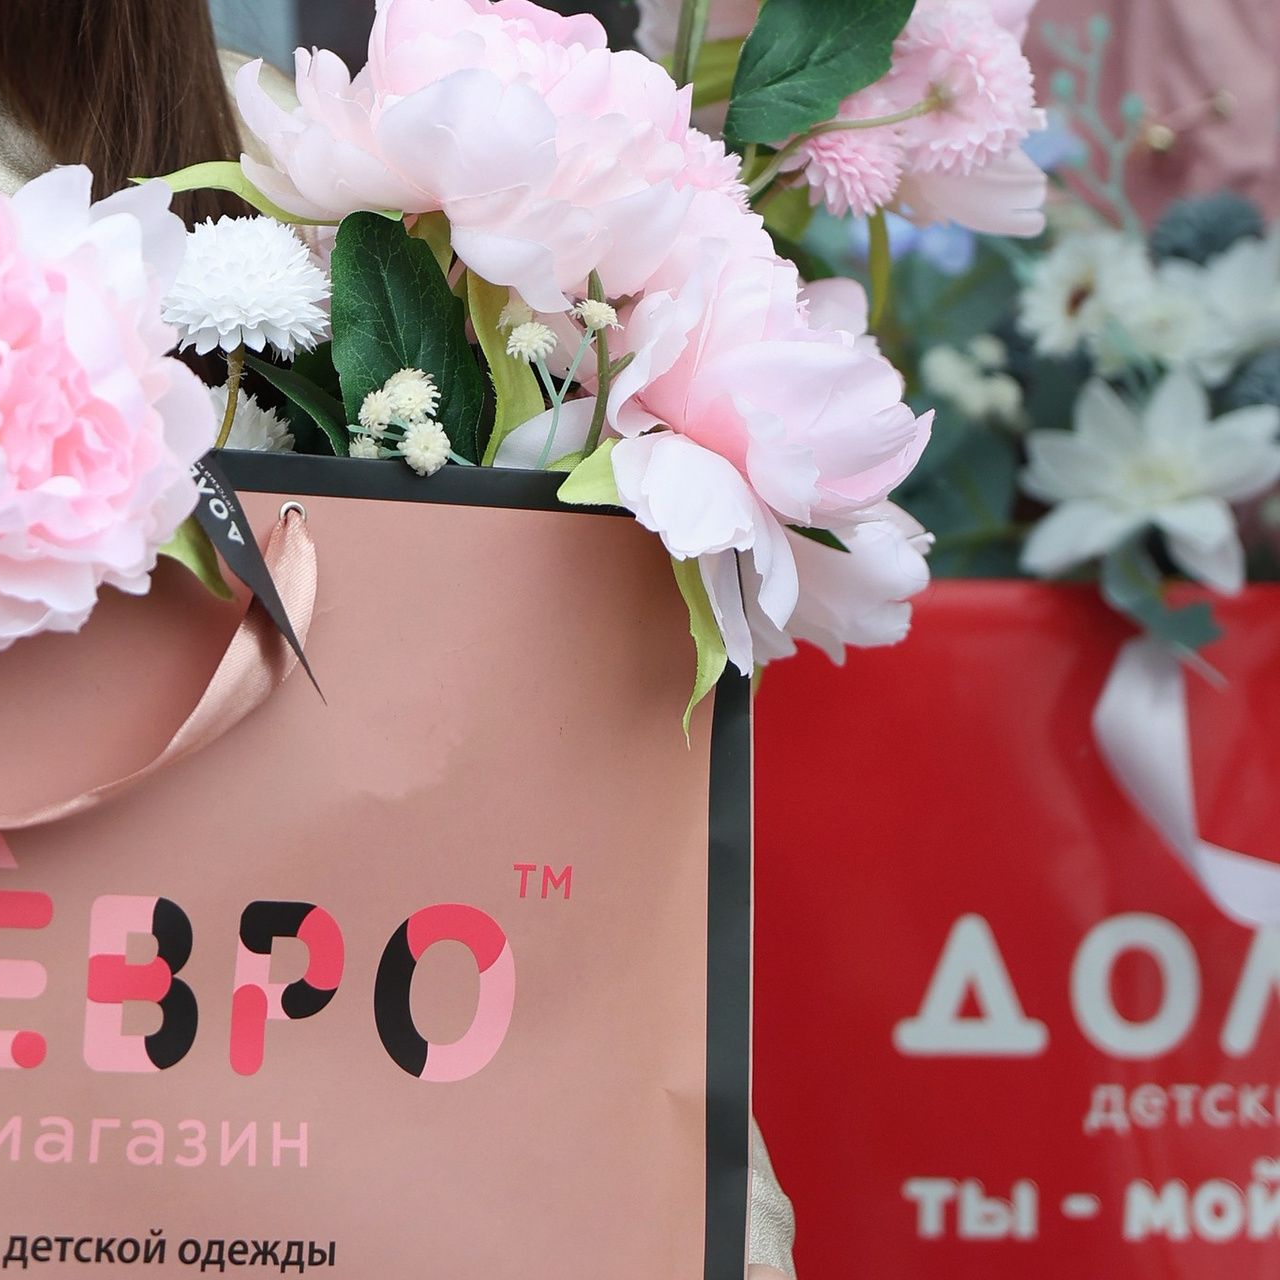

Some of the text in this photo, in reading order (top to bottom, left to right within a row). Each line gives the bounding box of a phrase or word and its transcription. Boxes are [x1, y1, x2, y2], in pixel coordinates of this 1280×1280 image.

[1082, 1082, 1280, 1136] детск
[2, 1228, 166, 1269] детской
[177, 1235, 337, 1274] одежды
